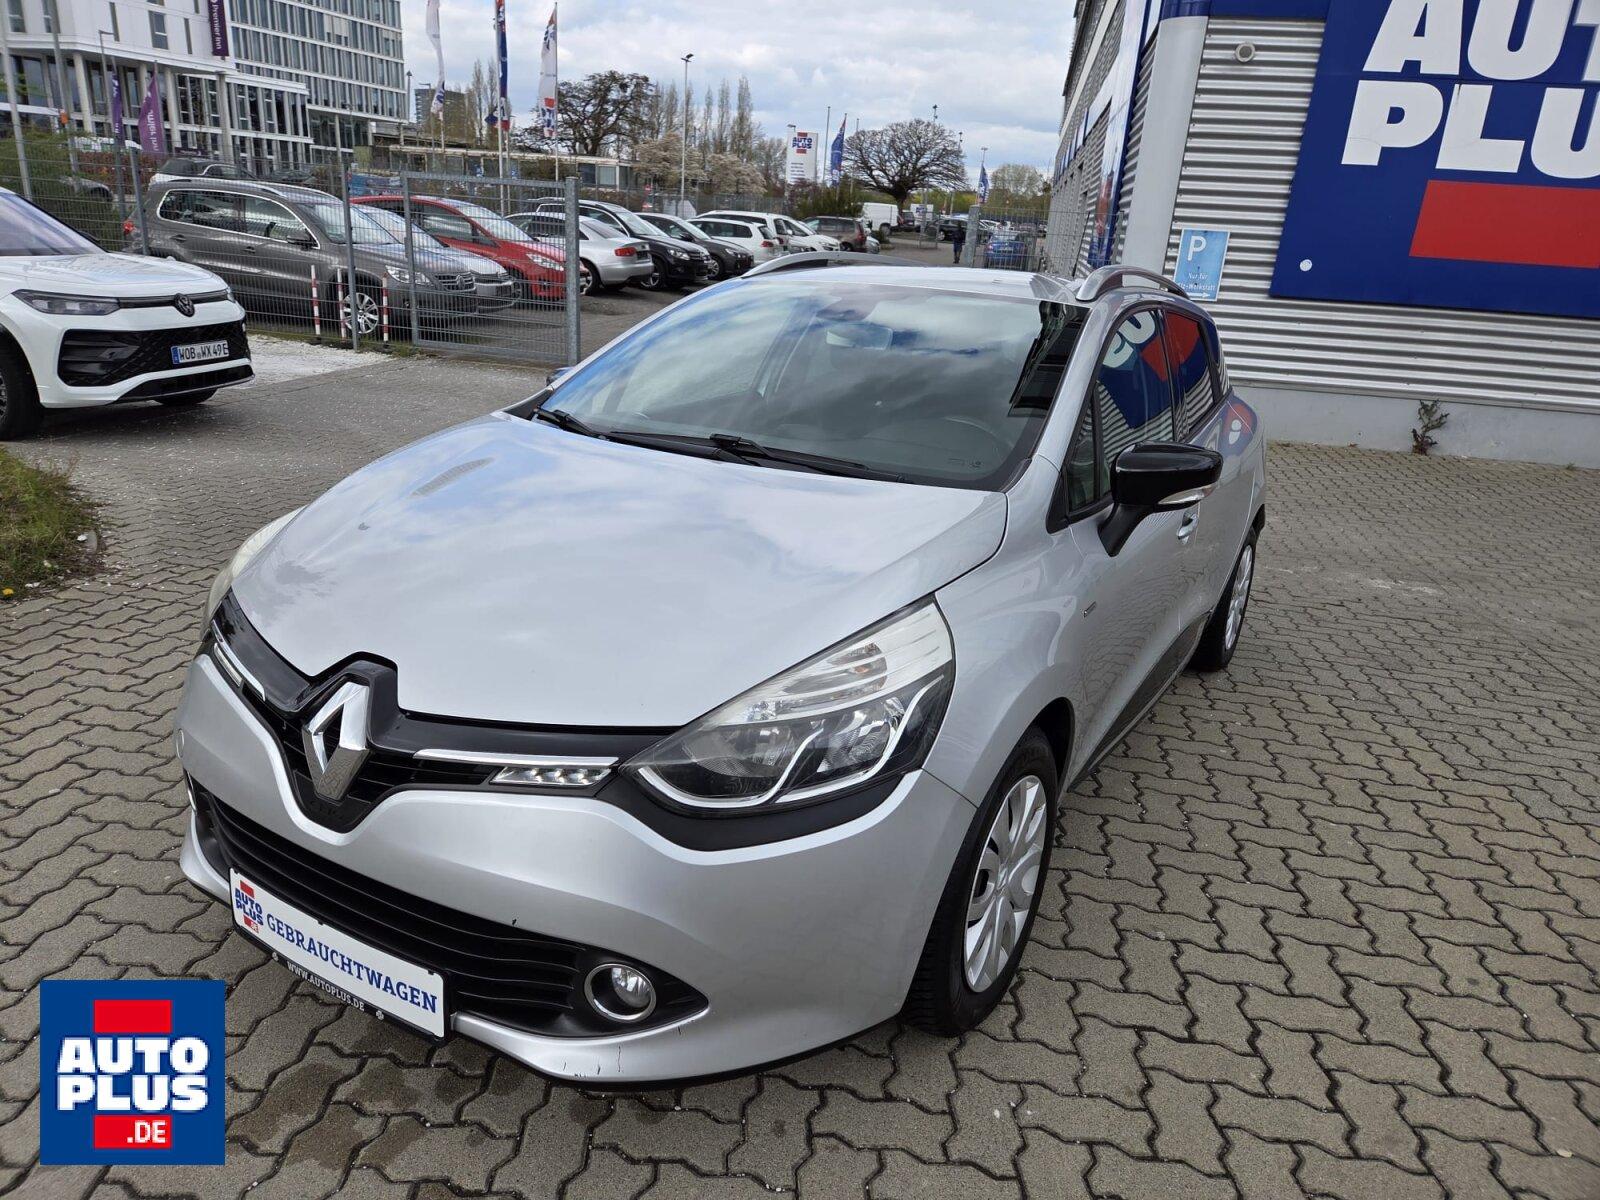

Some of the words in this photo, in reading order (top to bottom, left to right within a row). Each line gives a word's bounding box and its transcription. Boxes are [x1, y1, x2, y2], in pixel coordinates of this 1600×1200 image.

[1187, 235, 1207, 261] P
[179, 347, 196, 360] WOB
[235, 887, 263, 915] AUTO
[235, 898, 264, 926] PLUS
[266, 913, 438, 1013] GEBRAUCHTWAGEN
[287, 961, 365, 1012] WWW.AUTOPLUS.DE
